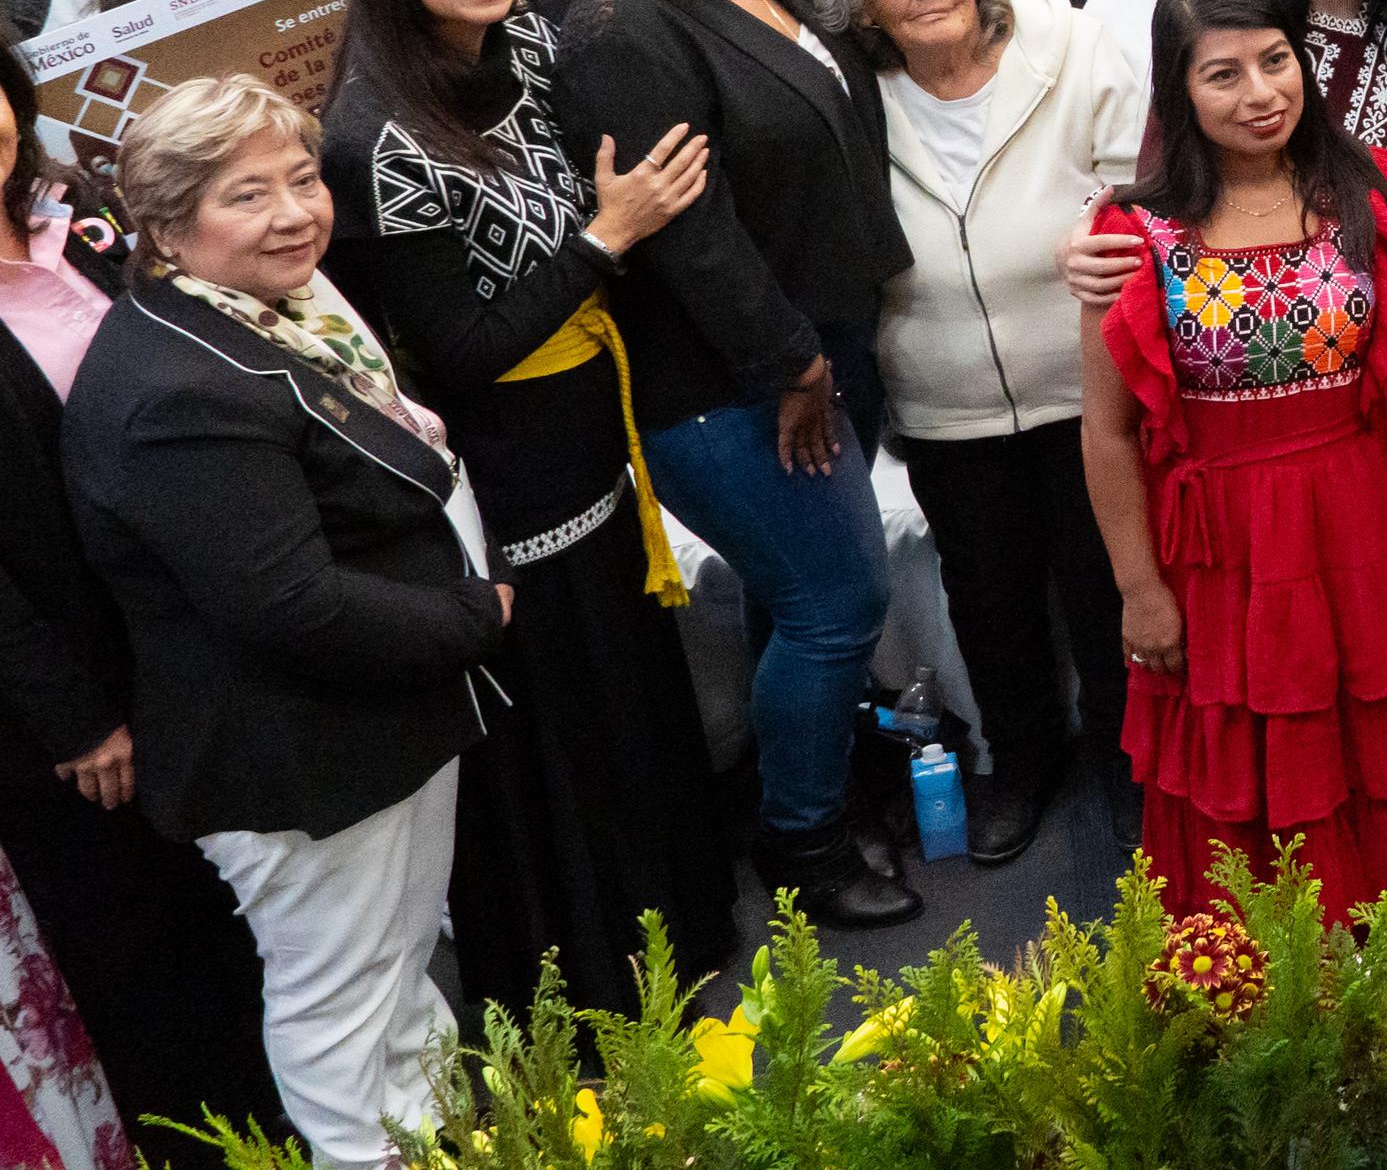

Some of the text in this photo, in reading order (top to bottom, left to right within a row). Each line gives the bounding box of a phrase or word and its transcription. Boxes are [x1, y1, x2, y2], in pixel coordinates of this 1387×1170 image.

[77, 30, 90, 42] de
[112, 14, 155, 39] Salud
[275, 17, 296, 32] Se
[32, 42, 95, 74] México
[259, 28, 337, 69] Comité
[275, 59, 326, 87] de la
